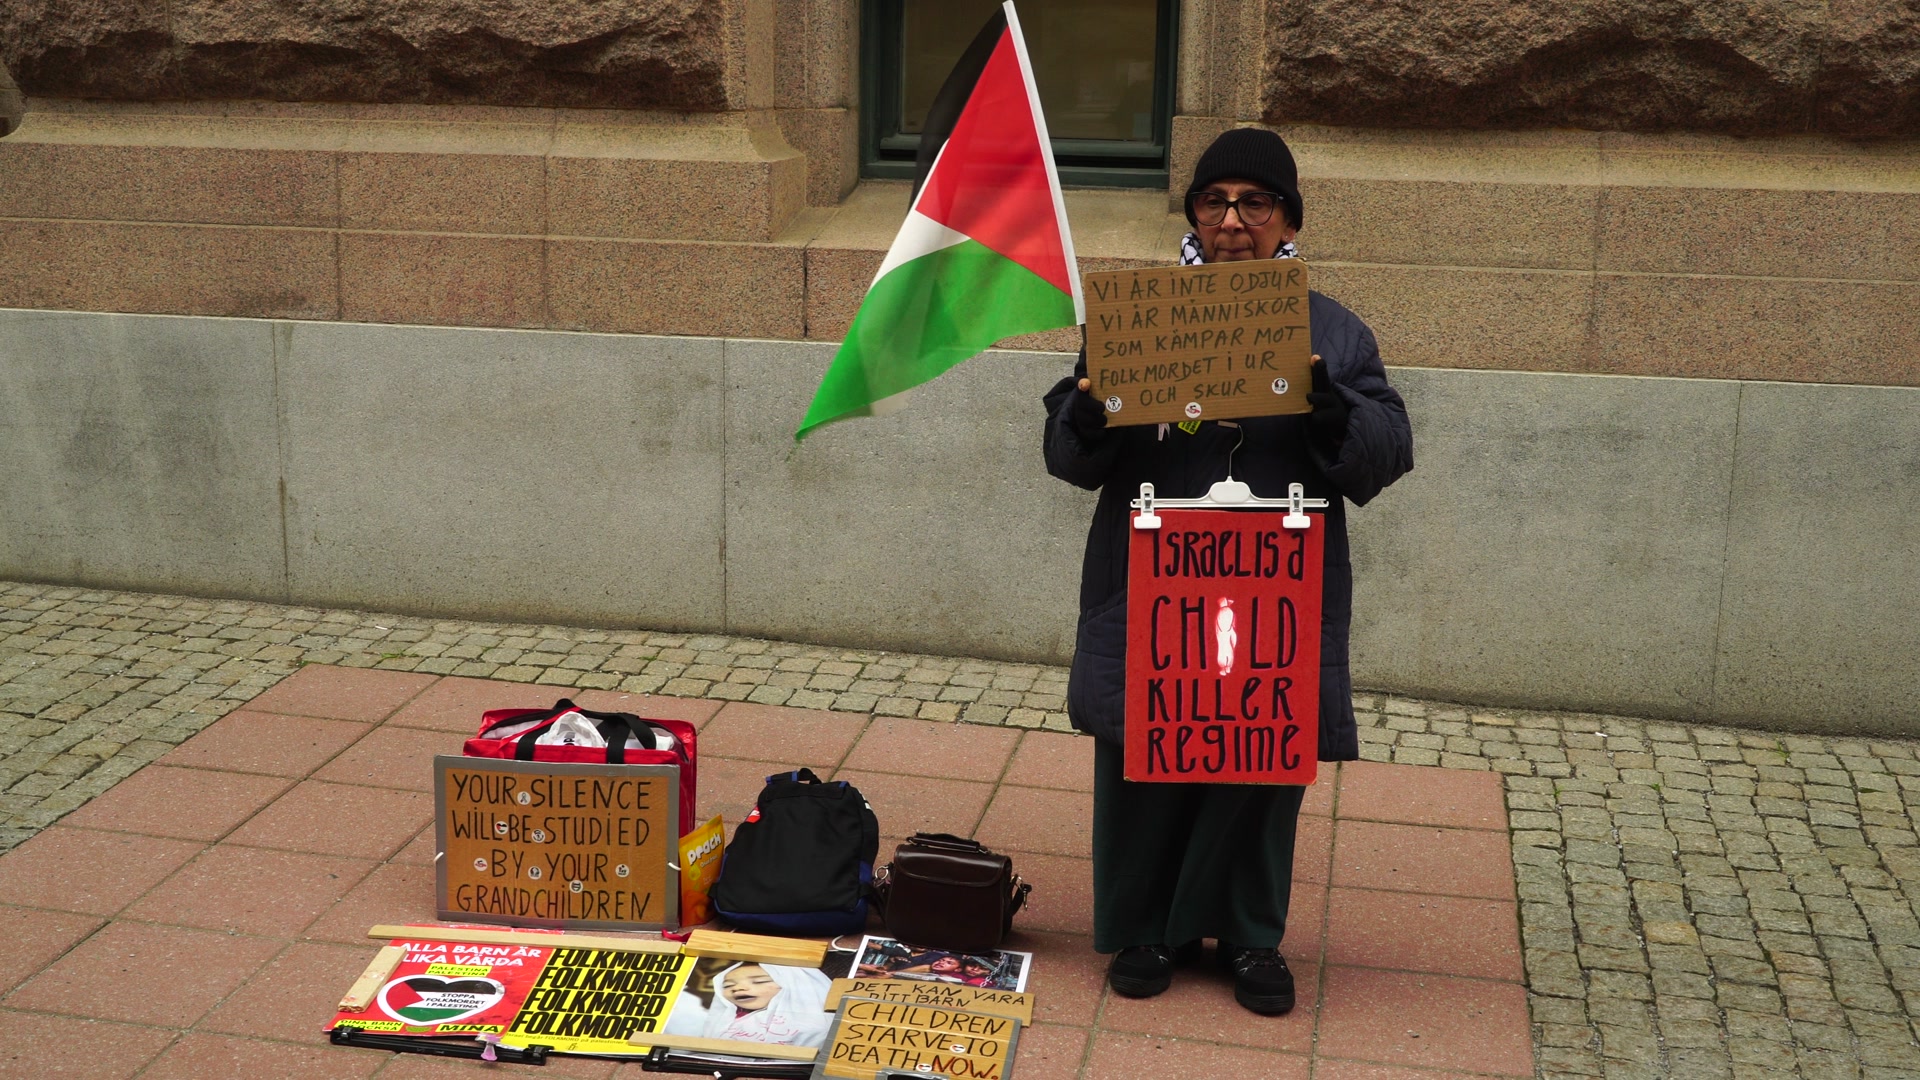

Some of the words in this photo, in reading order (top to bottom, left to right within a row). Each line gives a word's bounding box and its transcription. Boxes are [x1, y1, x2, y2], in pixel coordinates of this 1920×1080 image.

[1230, 268, 1301, 294] ODJUR
[1102, 340, 1143, 358] SOM
[1155, 327, 1245, 352] KÄMPAR
[1254, 325, 1307, 346] MOT
[1245, 350, 1279, 371] UR
[1140, 386, 1177, 406] OCH
[1193, 378, 1248, 399] SKUR
[452, 773, 517, 805] YOUR
[509, 814, 532, 844] BE
[491, 848, 524, 879] BY
[545, 852, 609, 883] YOUR
[401, 942, 447, 953] ALLA
[452, 944, 510, 957] BARN
[511, 946, 542, 958] ÄR
[402, 953, 448, 964] LIKA
[454, 954, 524, 967] VÄRDA
[547, 948, 686, 973] FOLKMORD
[430, 965, 489, 973] PALESTINA
[535, 967, 677, 994] FOLKMORD
[425, 997, 486, 1005] FOLKMORDET
[440, 992, 475, 1000] STOPPA
[522, 988, 668, 1018] FOLKMORD
[844, 981, 902, 993] DET
[911, 983, 963, 996] KAN
[973, 990, 1025, 1006] VARA
[915, 994, 973, 1008] BARN
[439, 1024, 500, 1033] MINA
[847, 1002, 1007, 1036] CHILDREN
[845, 1023, 953, 1051] STARVE
[963, 1036, 999, 1058] TO
[832, 1042, 920, 1071] DEATH
